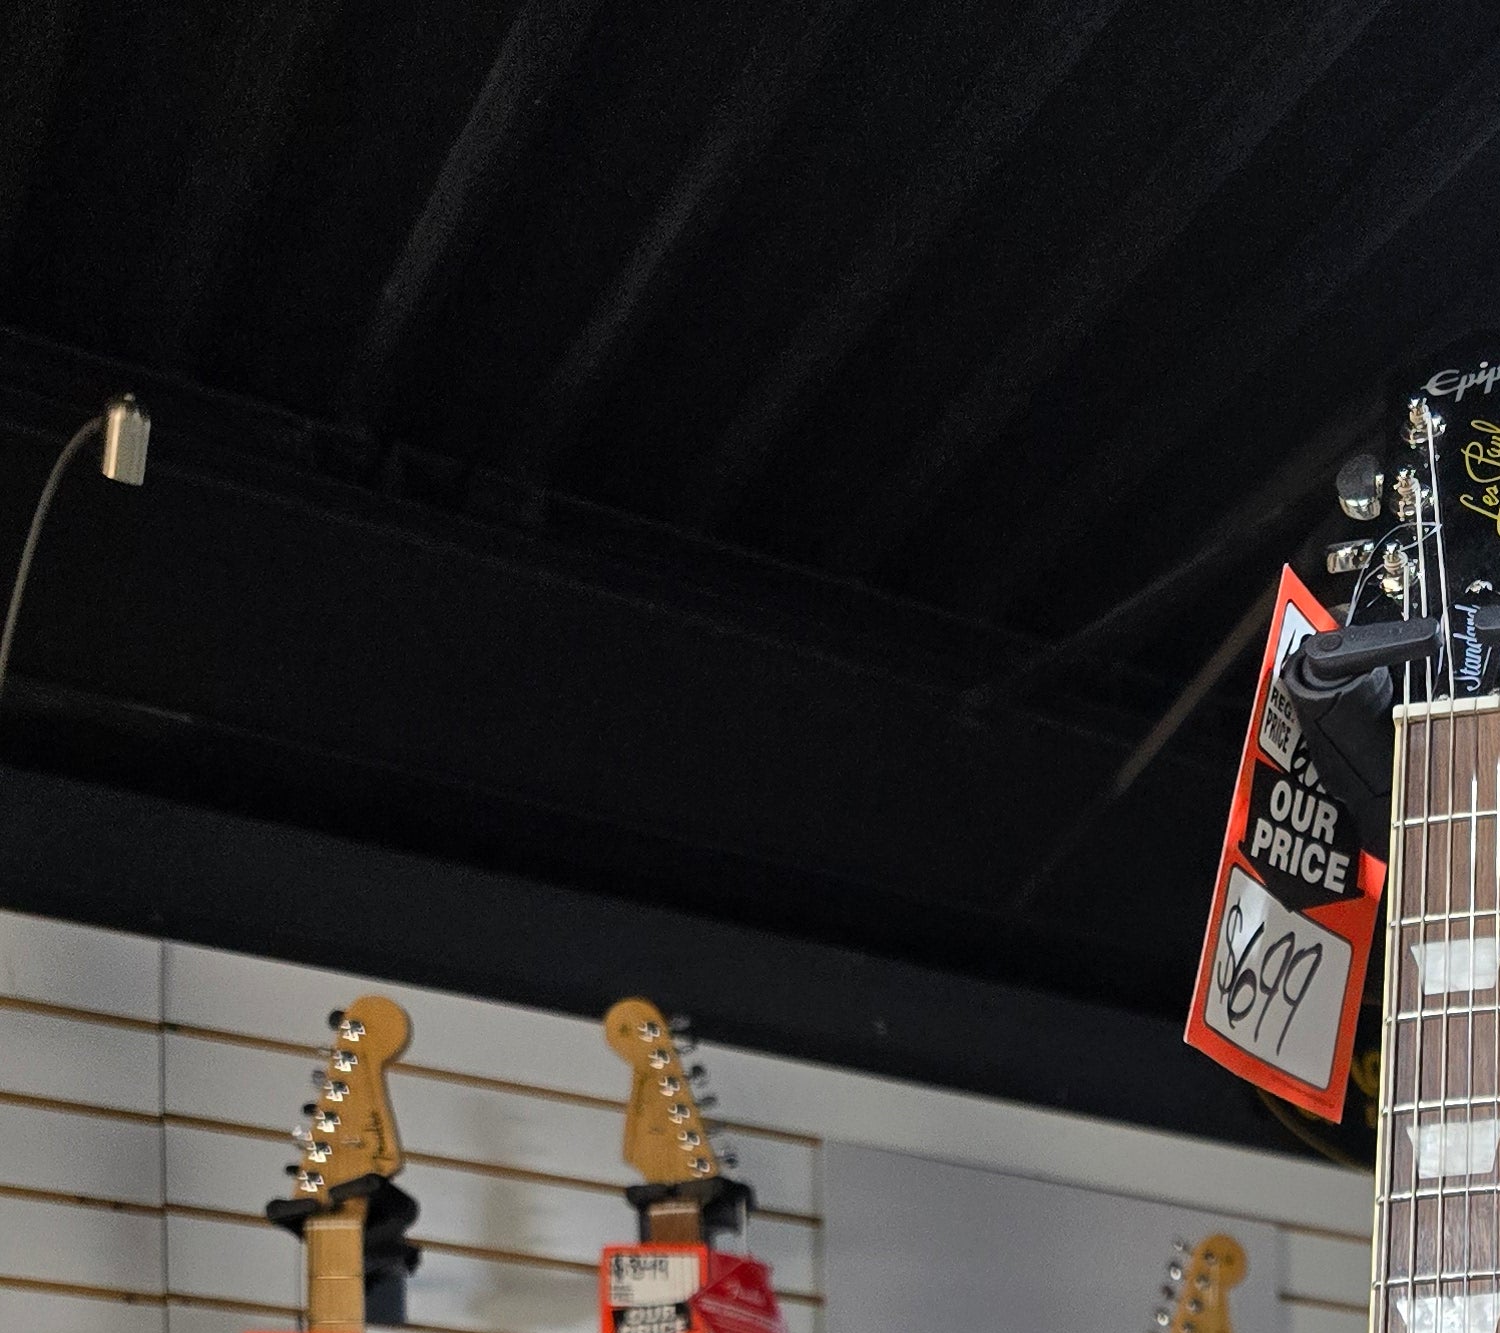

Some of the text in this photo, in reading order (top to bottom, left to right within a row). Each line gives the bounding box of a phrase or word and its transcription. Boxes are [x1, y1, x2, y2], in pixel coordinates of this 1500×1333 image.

[1454, 603, 1480, 692] Standard
[1263, 714, 1293, 752] PRICE
[1268, 779, 1340, 846] OUR
[1250, 817, 1351, 894] PRICE
[1216, 897, 1324, 1057] $699
